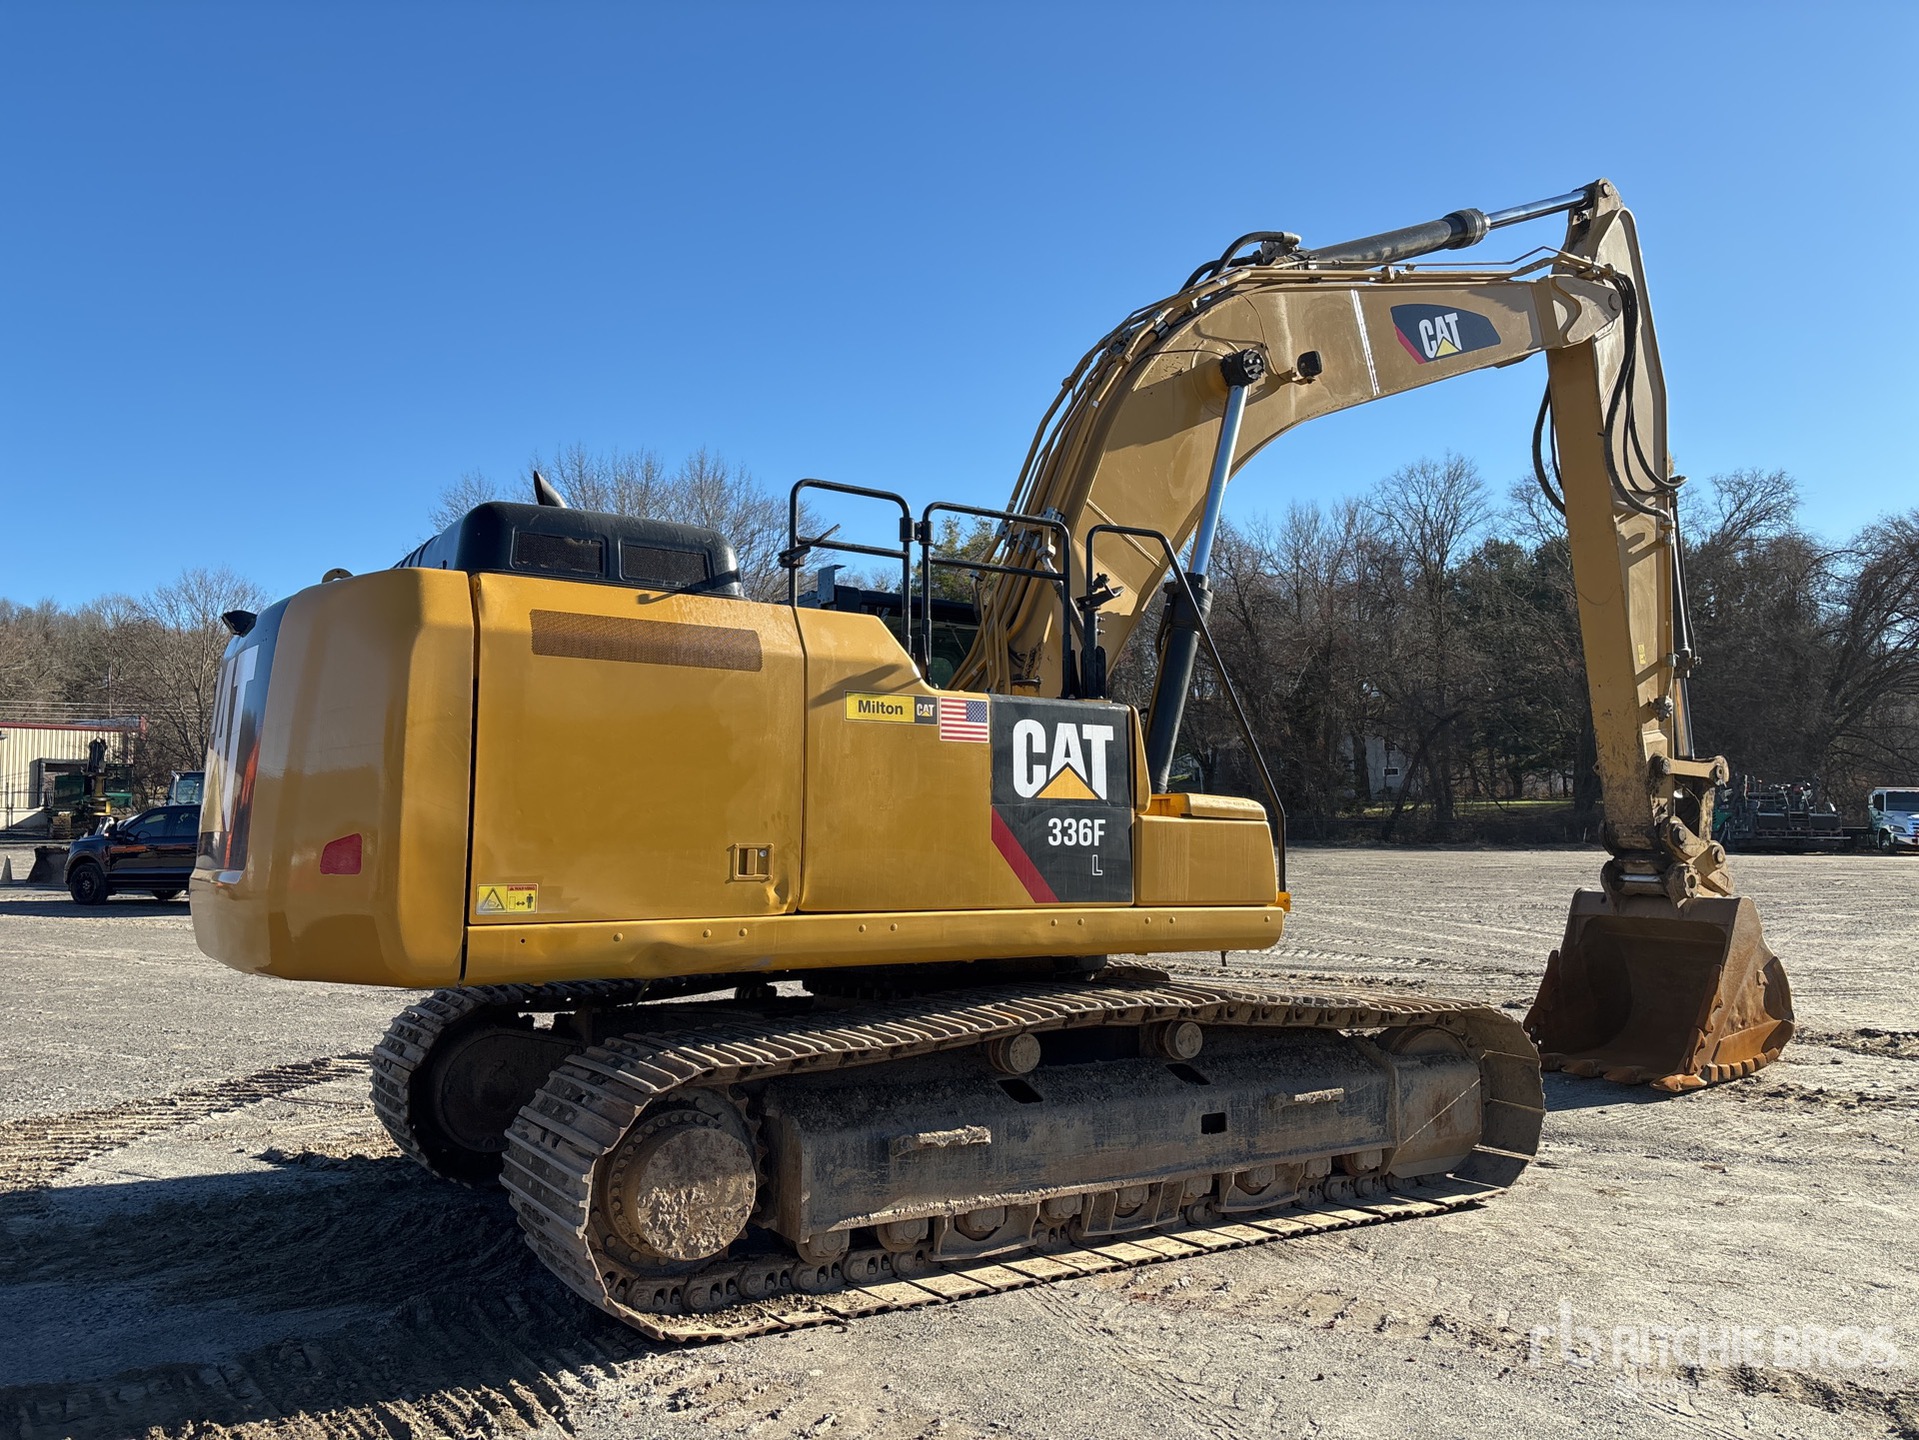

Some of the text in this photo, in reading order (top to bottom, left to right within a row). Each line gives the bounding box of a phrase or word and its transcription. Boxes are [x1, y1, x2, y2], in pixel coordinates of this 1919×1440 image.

[1419, 312, 1462, 359] CAT
[858, 700, 935, 717] Milton CAT
[1013, 719, 1114, 800] CAT
[1048, 818, 1106, 847] 336F
[1092, 855, 1103, 876] L
